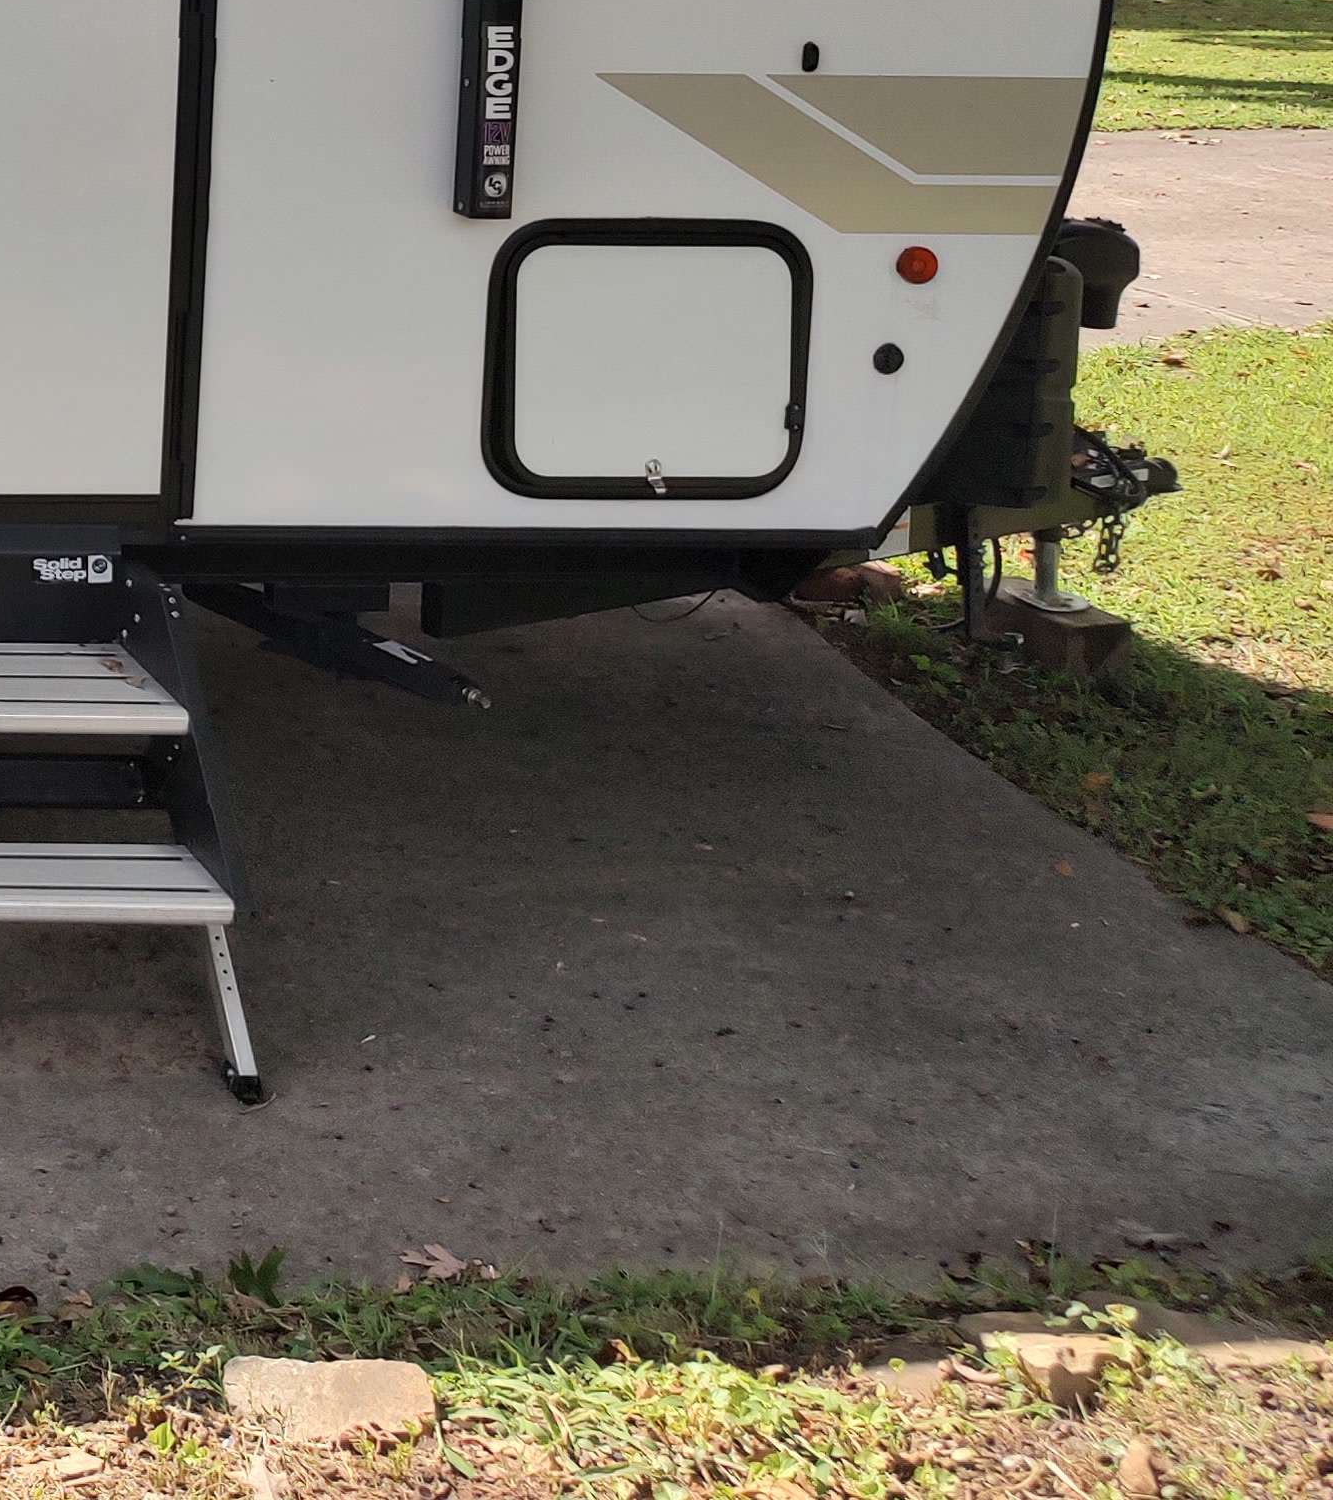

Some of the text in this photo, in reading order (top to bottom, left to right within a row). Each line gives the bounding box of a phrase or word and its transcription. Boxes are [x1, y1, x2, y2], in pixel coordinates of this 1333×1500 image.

[485, 25, 515, 120] EDGE
[483, 122, 512, 144] 12V
[484, 144, 511, 156] POWER
[33, 557, 82, 570] Solid
[39, 569, 87, 582] Step
